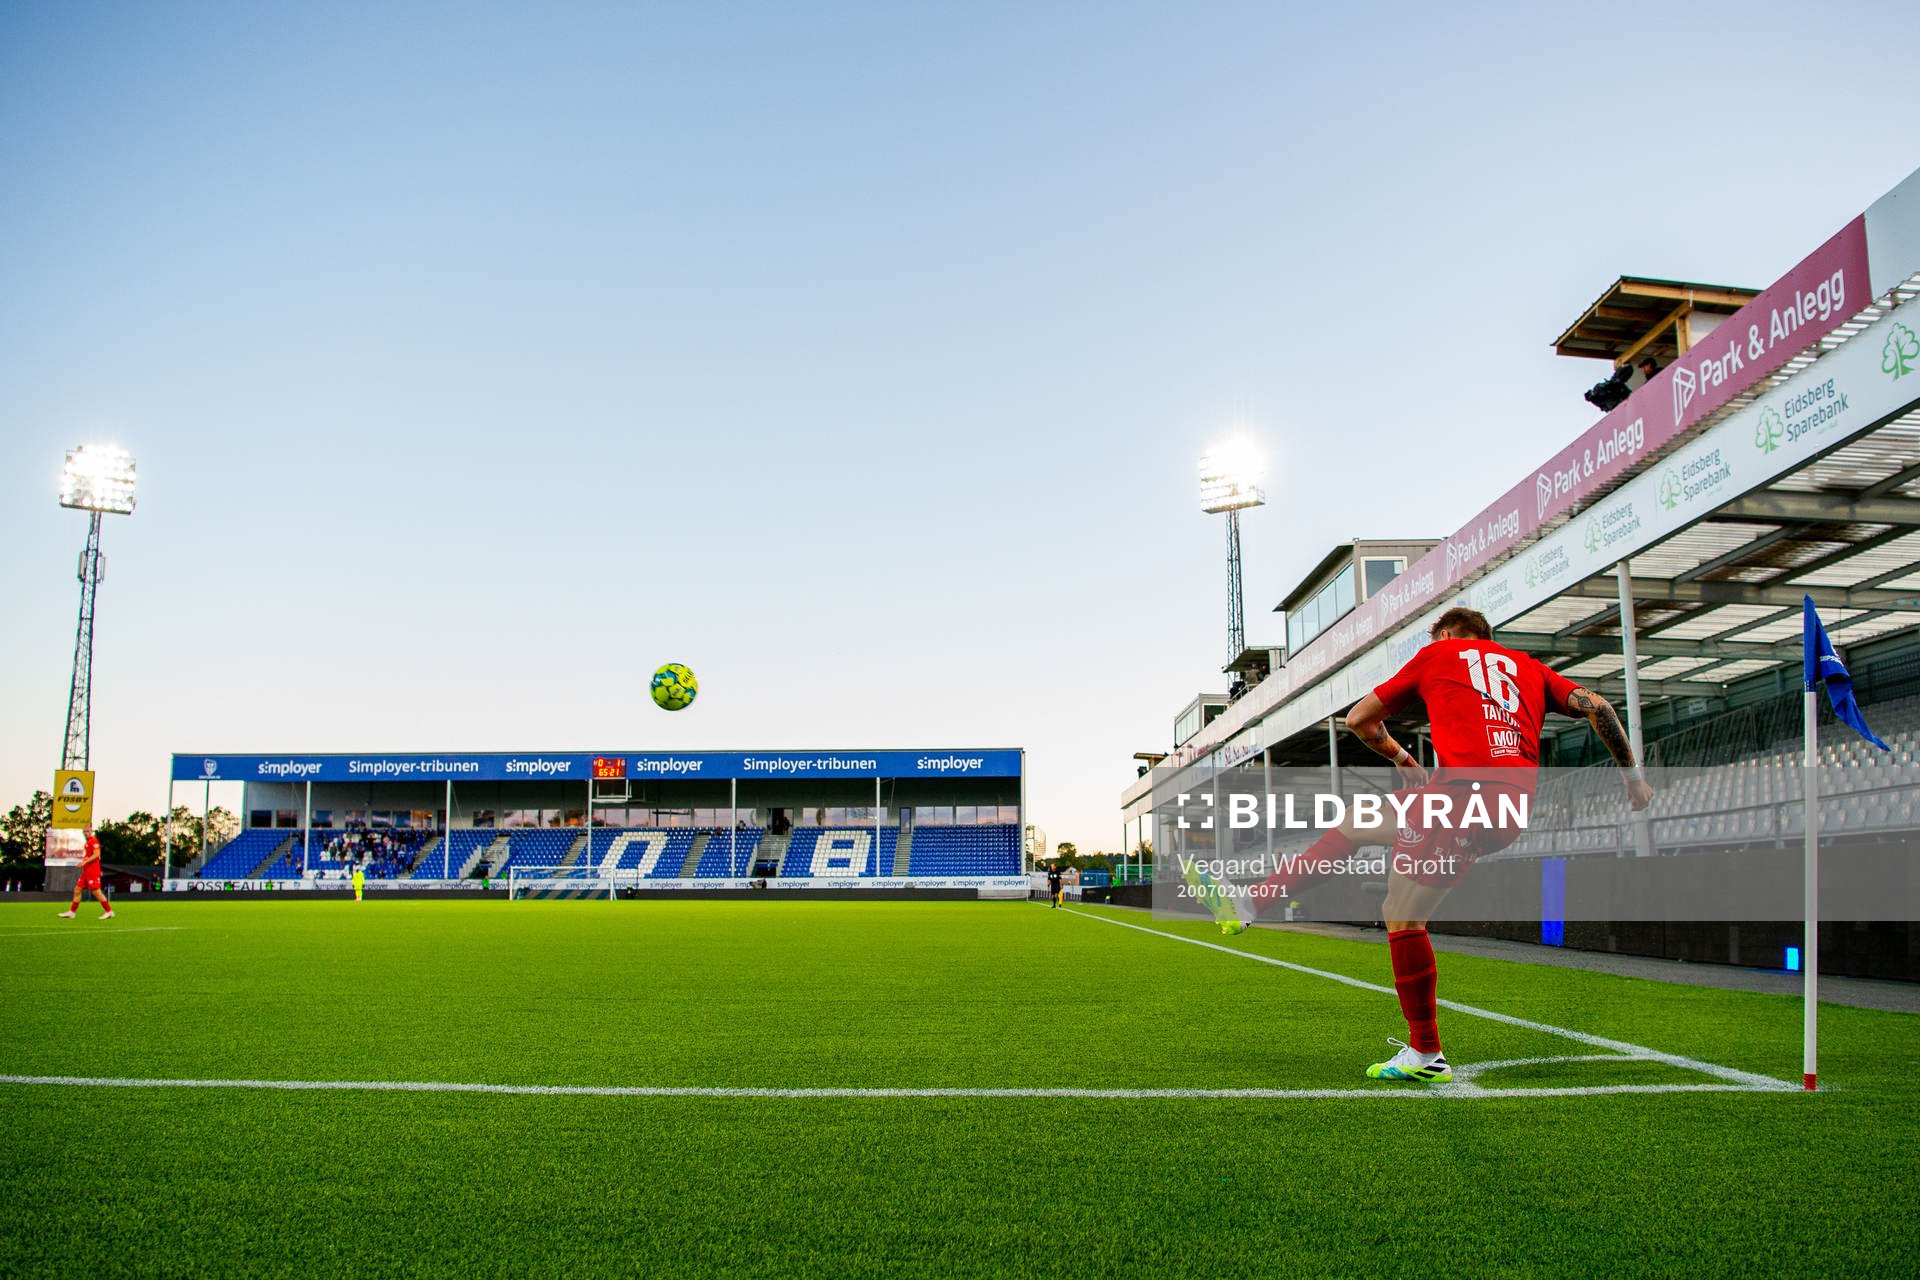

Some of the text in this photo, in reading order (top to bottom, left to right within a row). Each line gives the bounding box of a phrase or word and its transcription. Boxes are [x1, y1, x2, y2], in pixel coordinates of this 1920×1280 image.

[1700, 268, 1846, 396] Park & Anlegg
[1784, 378, 1835, 419] Eidsberg
[1786, 391, 1848, 442] Sparebank
[1554, 417, 1644, 499] Park & Anlegg
[1682, 448, 1721, 481] Eidsberg
[1683, 462, 1731, 502] Sparebank
[1459, 508, 1519, 567] Park & Anlegg
[1459, 648, 1520, 713] 16
[258, 760, 322, 777] simployer
[349, 759, 479, 776] Simployer-tribunen
[506, 758, 571, 775] simployer
[637, 758, 703, 774] simployer
[743, 757, 877, 773] Simployer-tribunen
[917, 756, 983, 771] simployer
